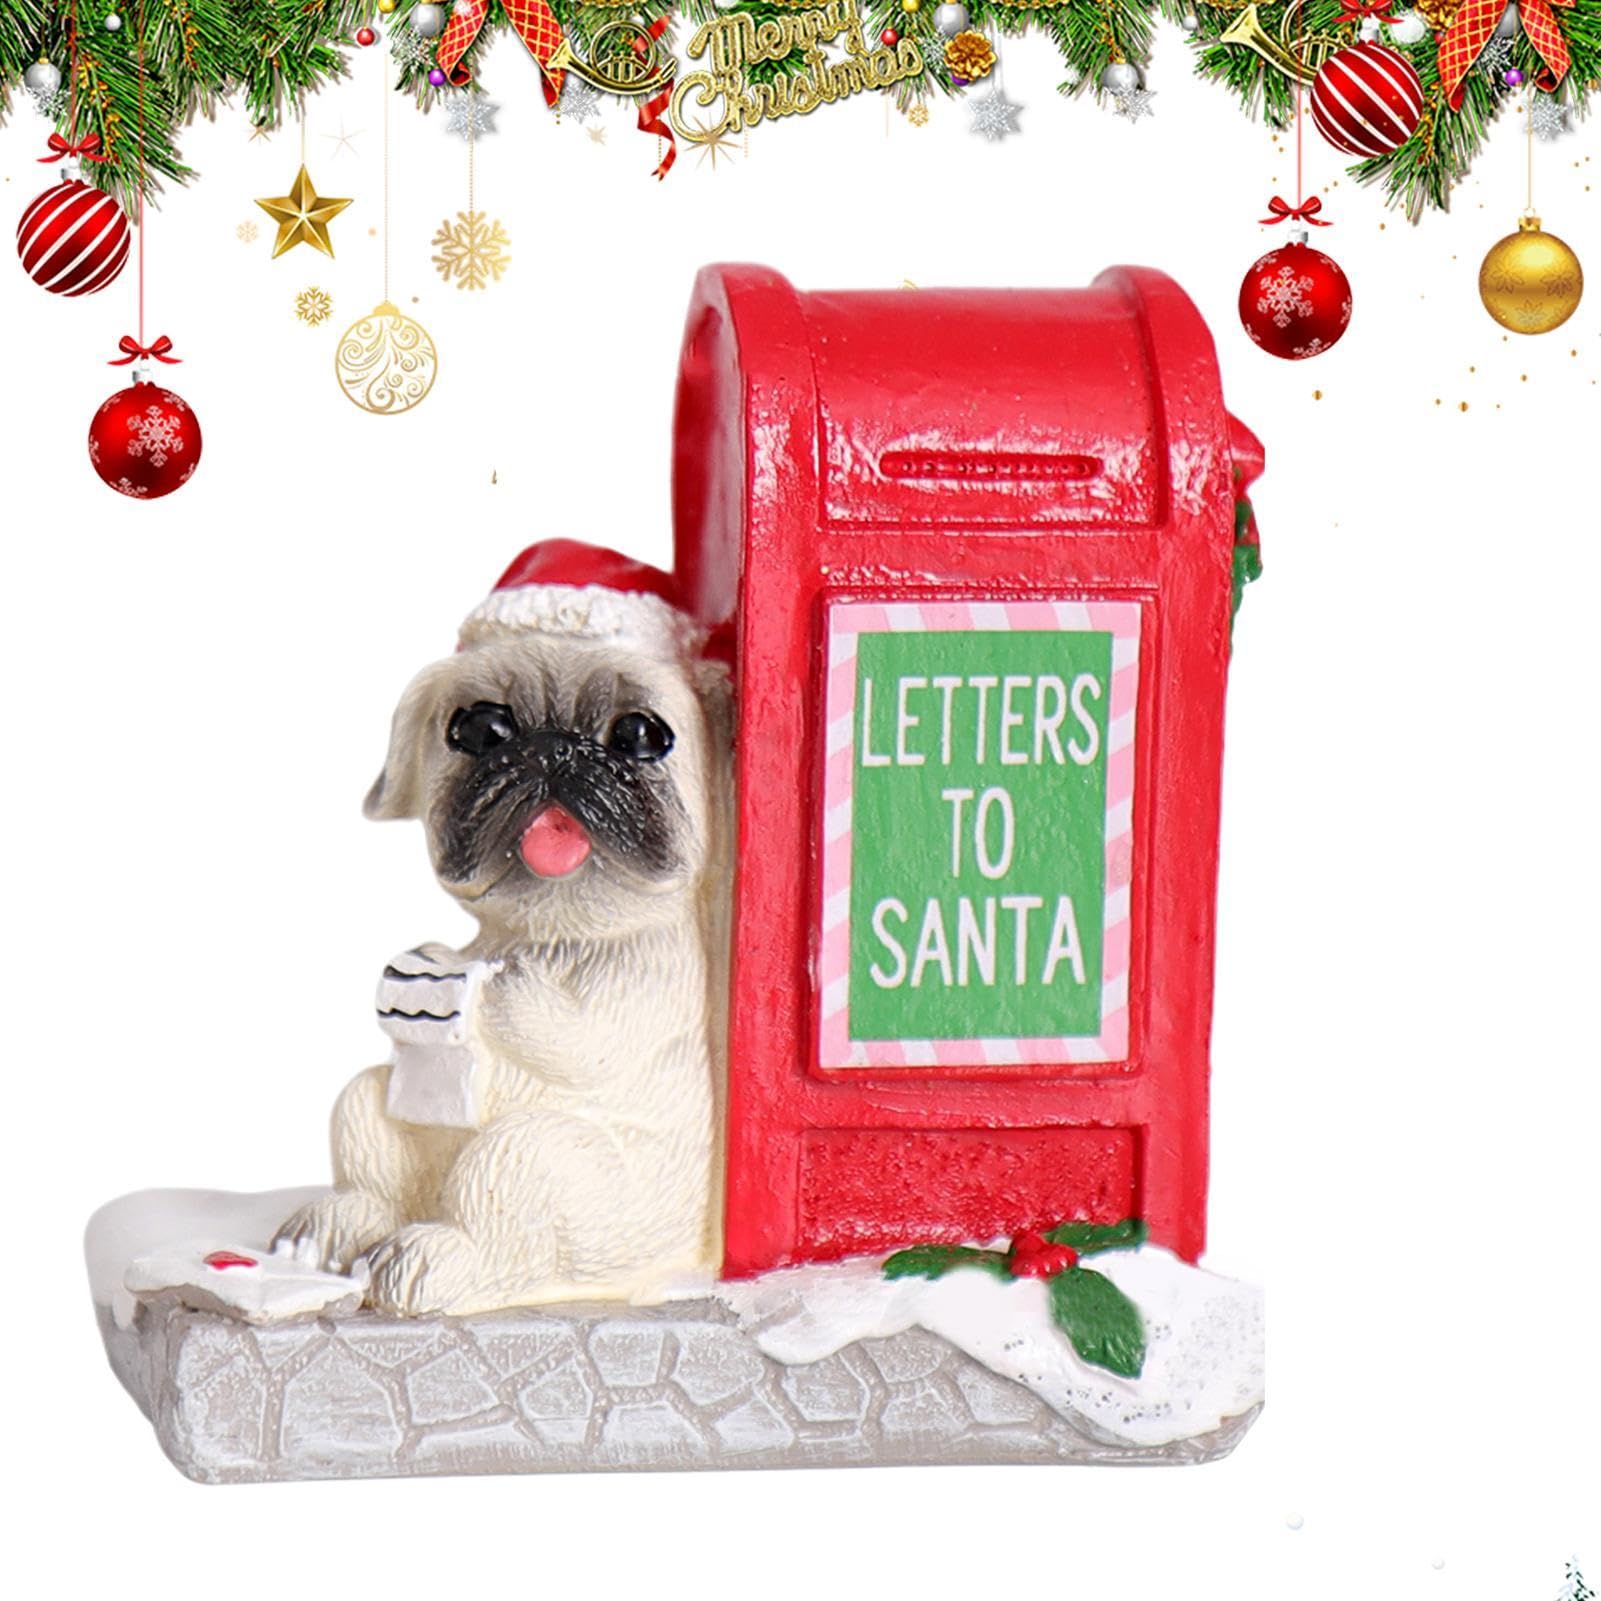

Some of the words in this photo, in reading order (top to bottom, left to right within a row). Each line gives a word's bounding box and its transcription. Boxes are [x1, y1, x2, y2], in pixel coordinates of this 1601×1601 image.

[862, 673, 1101, 767] LETTERS
[941, 787, 1015, 880] TO
[870, 895, 1087, 988] SANTA
